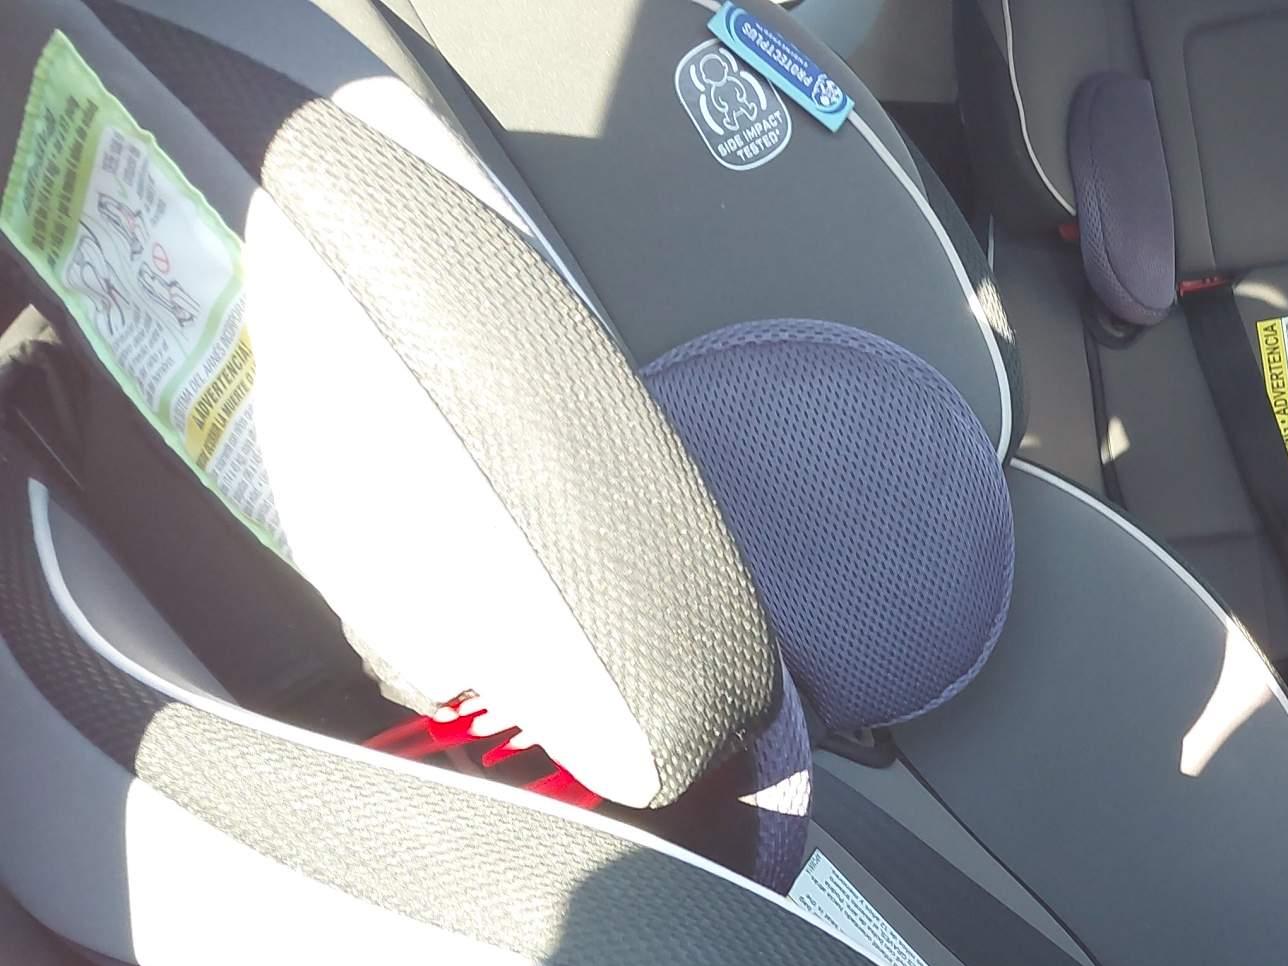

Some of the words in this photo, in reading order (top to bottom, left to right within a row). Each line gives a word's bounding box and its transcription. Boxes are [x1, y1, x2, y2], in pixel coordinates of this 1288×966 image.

[718, 134, 742, 157] SIDE
[743, 110, 783, 142] IMPACT
[1263, 323, 1288, 416] ADVERTENCIA
